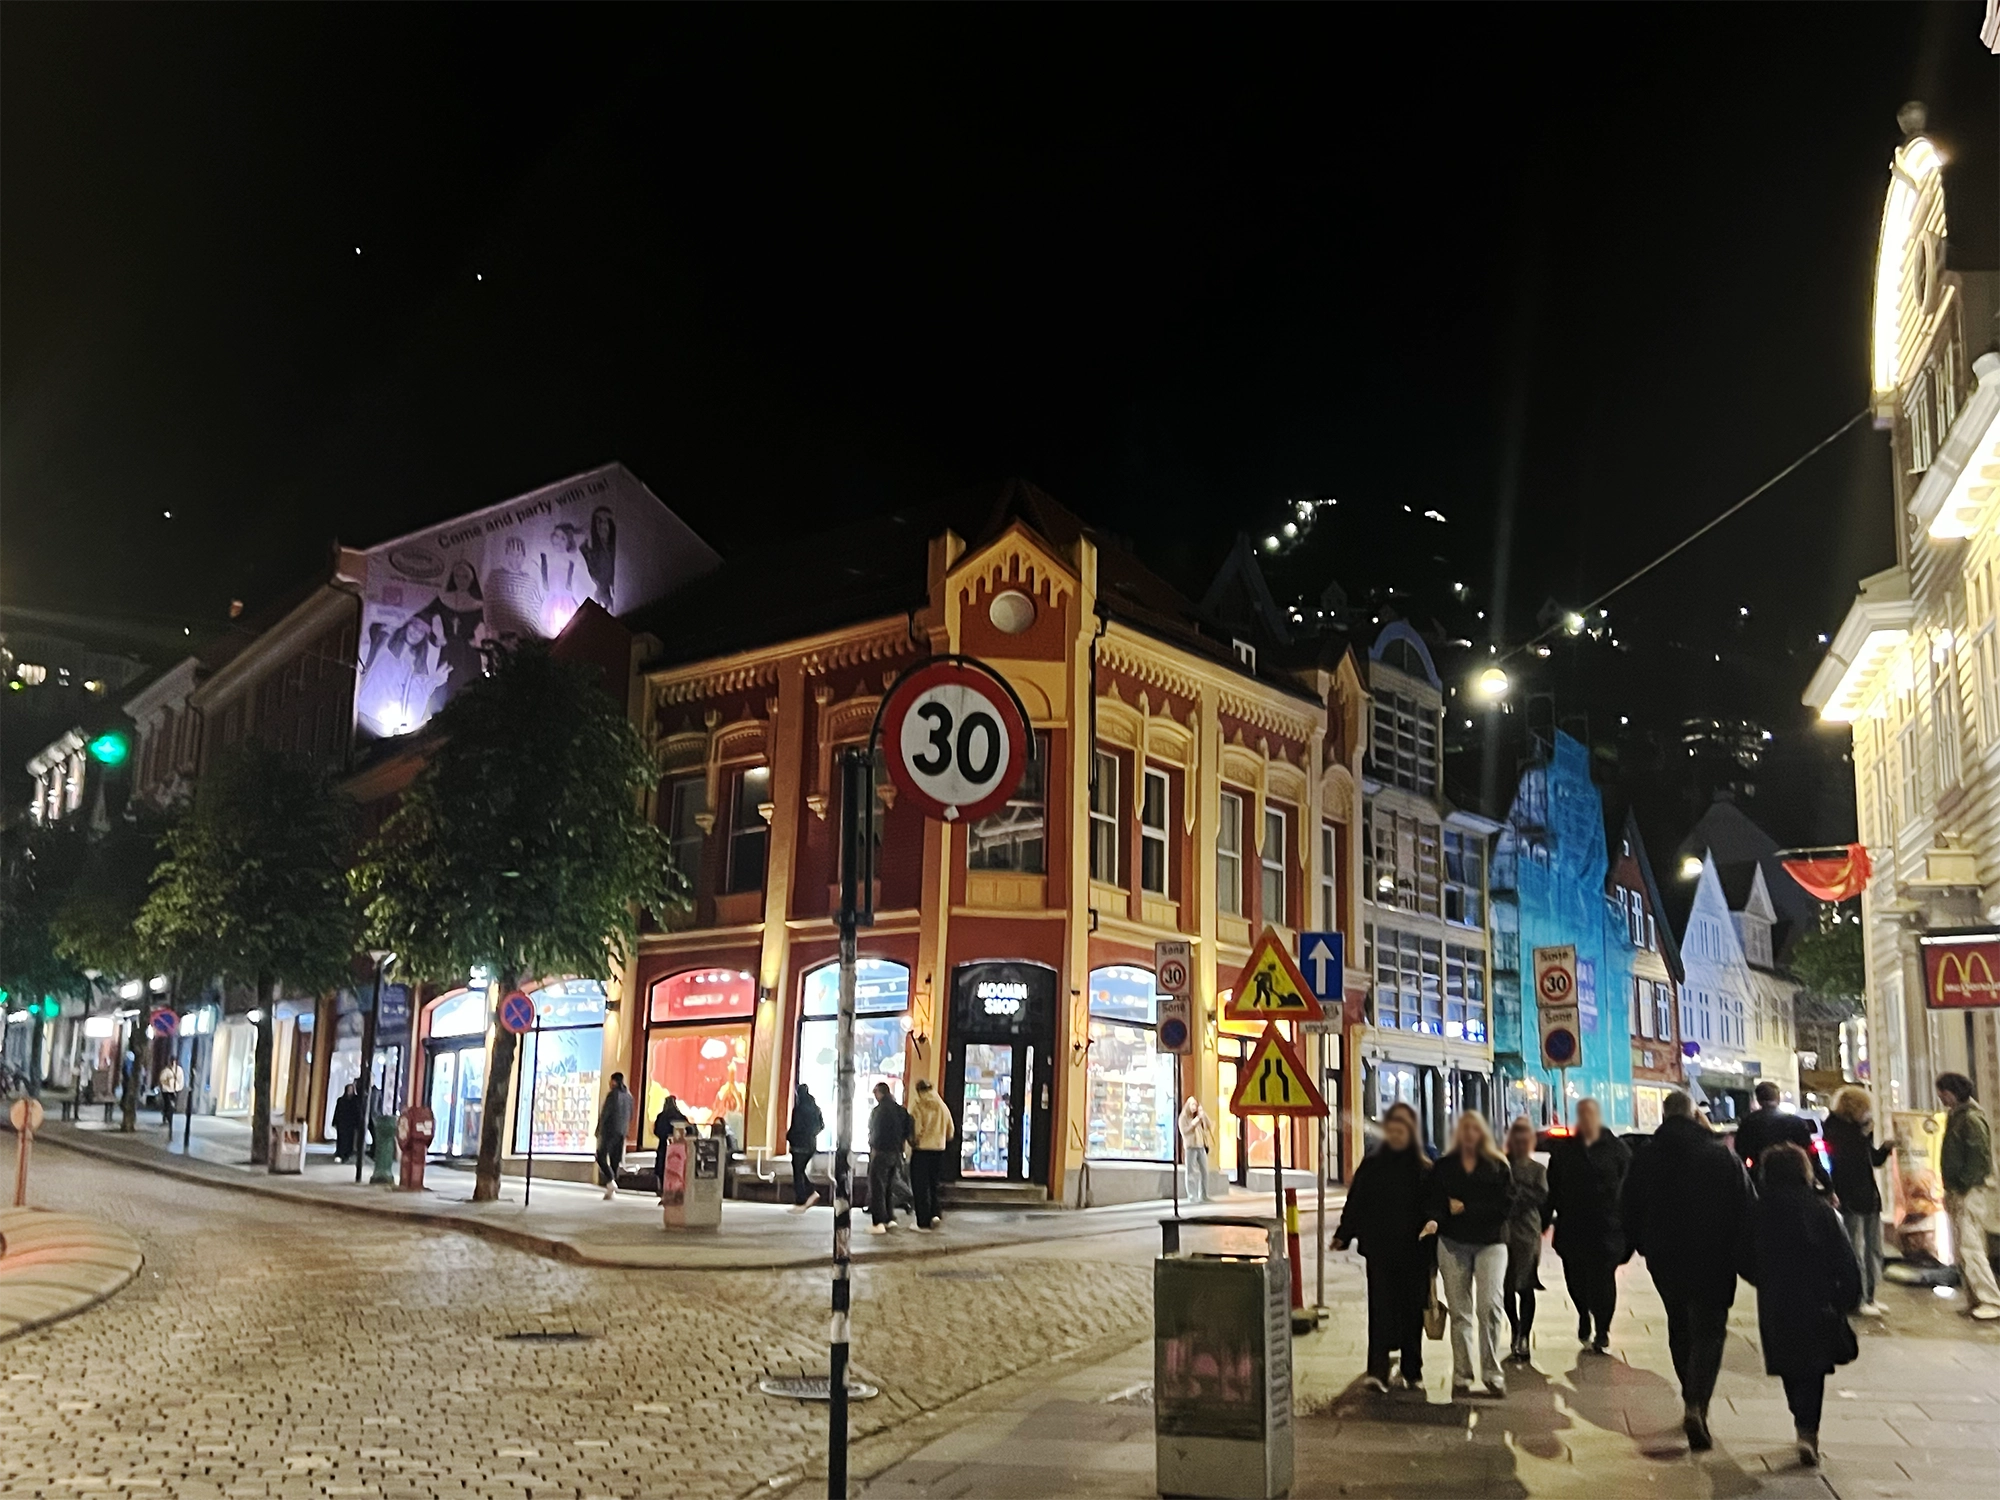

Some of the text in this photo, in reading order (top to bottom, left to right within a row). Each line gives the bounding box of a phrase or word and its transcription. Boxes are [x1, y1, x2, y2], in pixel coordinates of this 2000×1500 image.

[437, 525, 482, 549] Come
[485, 512, 513, 533] and
[516, 500, 552, 525] party
[555, 487, 586, 508] with
[912, 701, 1001, 785] 30
[1164, 967, 1182, 985] 30
[1546, 975, 1567, 993] 30
[984, 999, 1020, 1014] SHOP
